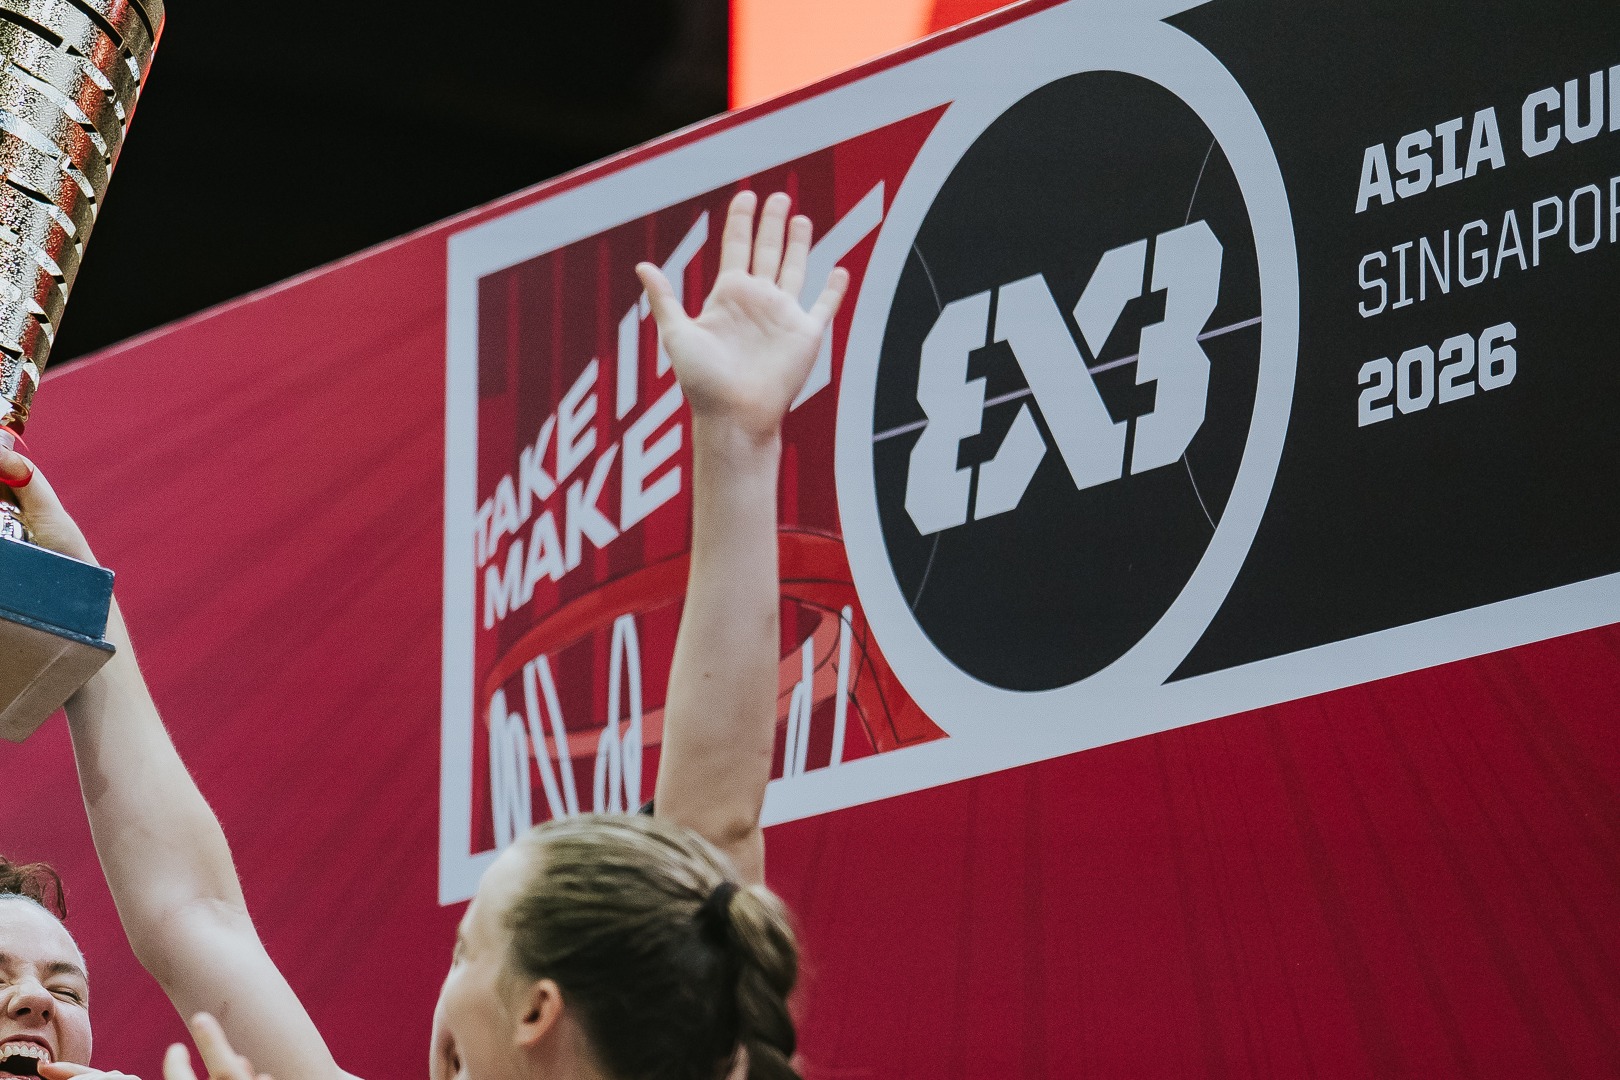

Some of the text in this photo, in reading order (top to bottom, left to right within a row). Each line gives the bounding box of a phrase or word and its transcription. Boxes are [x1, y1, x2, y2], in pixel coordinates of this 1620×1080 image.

[1355, 106, 1506, 214] ASIA
[1358, 176, 1620, 319] SINGAPO
[1358, 321, 1517, 427] 2026
[474, 358, 599, 566] TAKE
[484, 384, 683, 630] MAKE
